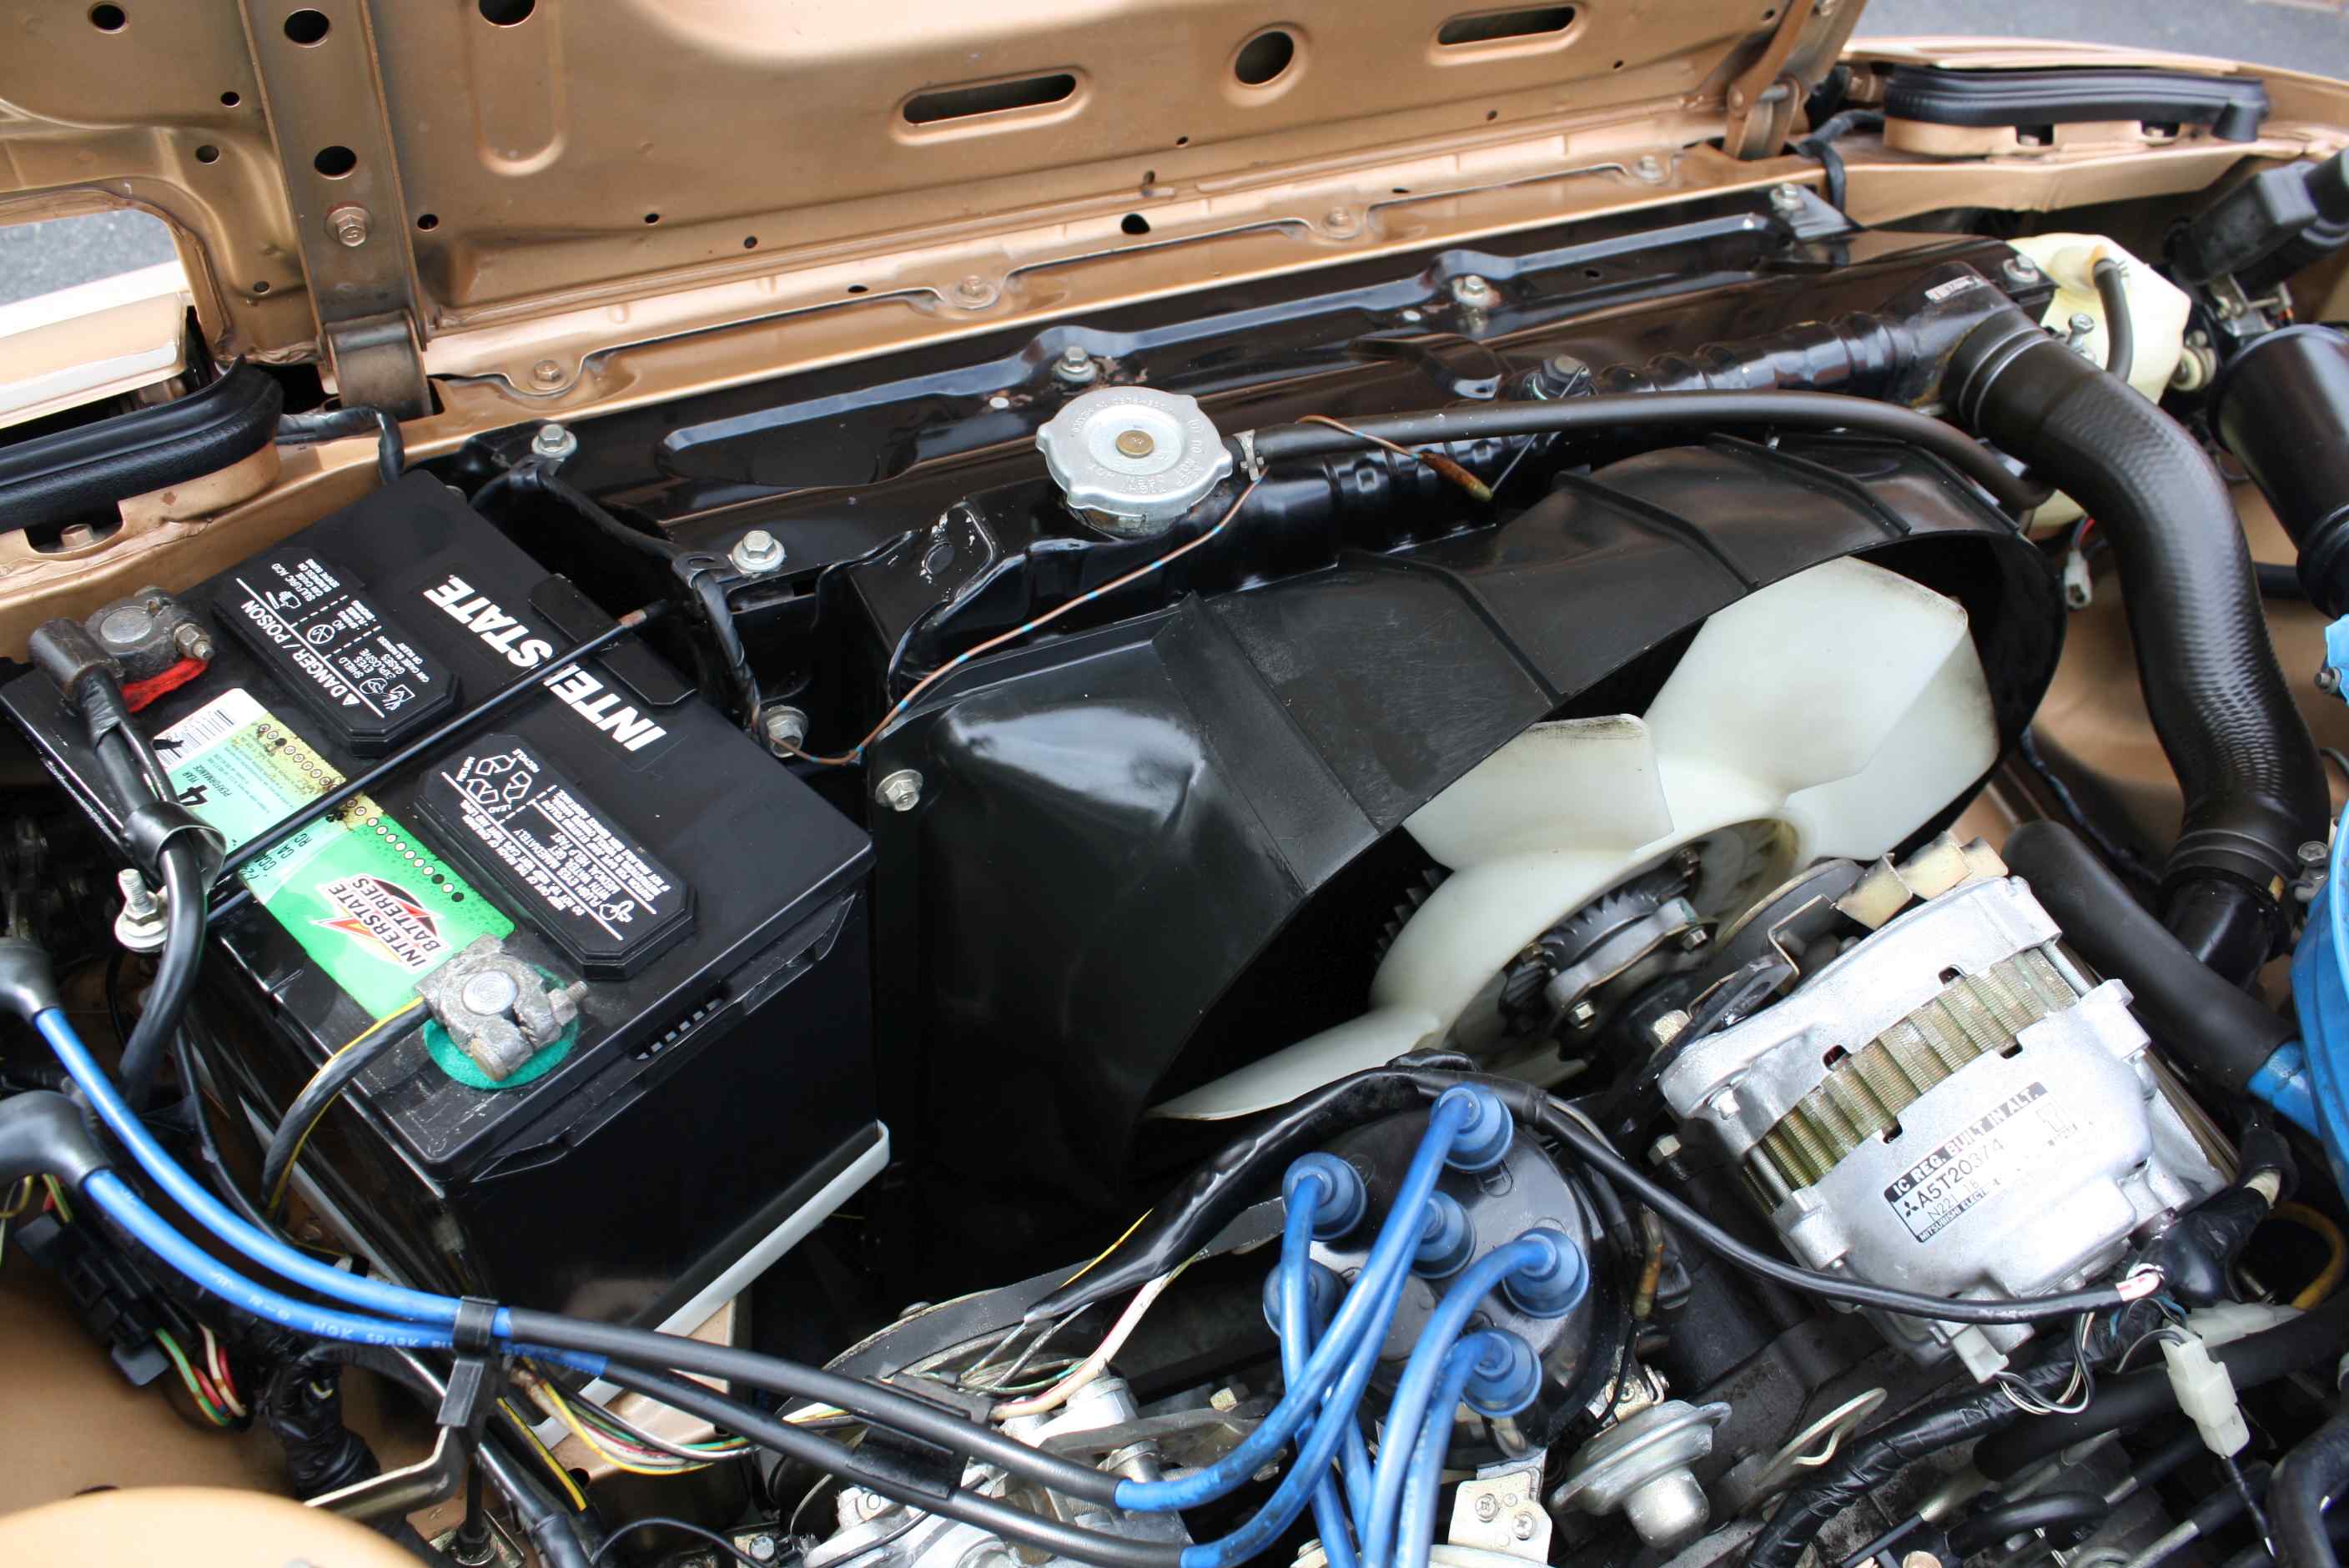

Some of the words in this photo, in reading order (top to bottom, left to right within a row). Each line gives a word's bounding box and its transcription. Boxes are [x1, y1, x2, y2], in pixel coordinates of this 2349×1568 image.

[269, 561, 289, 577] ACID
[295, 562, 309, 571] OR
[284, 574, 317, 602] SULFURIC
[294, 571, 314, 588] CAUSE
[304, 568, 333, 593] BLINDNESS
[319, 570, 340, 589] SEVERE
[309, 585, 324, 596] CAN
[238, 599, 292, 644] POISON
[330, 618, 347, 631] NO
[280, 639, 301, 652] /
[375, 635, 405, 660] BLINDNESS
[395, 641, 416, 658] INJURY
[336, 656, 365, 679] SHIELD
[351, 655, 375, 673] EYES
[357, 646, 397, 681] EXPLOSIVE
[379, 652, 407, 676] GASES
[400, 657, 420, 674] CAUSE
[410, 656, 424, 665] OR
[289, 647, 350, 698] DANGER
[415, 671, 431, 683] CAN
[511, 747, 541, 773] RECYCLE
[181, 770, 199, 783] YEAR
[192, 763, 233, 797] PERFORMANCE
[179, 785, 209, 807] 4
[458, 798, 480, 817] LEVEL
[488, 803, 511, 812] LEAD
[460, 813, 493, 841] CHILDREN
[473, 813, 491, 827] AND
[292, 832, 313, 847] RC
[485, 837, 500, 849] OF
[501, 840, 522, 857] CAPS
[511, 827, 562, 870] IMMEDIATELY
[548, 830, 574, 850] FAST
[274, 844, 295, 860] CA
[494, 846, 519, 866] REACH
[546, 842, 569, 861] GET
[566, 847, 592, 867] HELP
[512, 862, 530, 876] THE
[516, 854, 537, 871] VENT
[524, 873, 540, 885] OF
[531, 867, 552, 884] KEEP
[555, 867, 580, 887] EYES
[585, 863, 622, 894] MEDICAL
[613, 866, 631, 880] FOR
[533, 882, 552, 897] OUT
[572, 882, 603, 907] FLUSH
[586, 880, 612, 901] WITH
[546, 893, 567, 911] KEEP
[557, 892, 576, 907] NOT
[350, 877, 441, 952] BATTERIES
[570, 904, 586, 917] DO
[326, 882, 426, 967] INTERSTATE
[1892, 1176, 1911, 1198] IC
[1909, 1148, 1946, 1184] REG.
[1944, 1119, 1987, 1158] BUILT
[1986, 1104, 2007, 1128] IN
[2004, 1083, 2039, 1116] ALT.
[1919, 1205, 1962, 1241] MITSUBISHI
